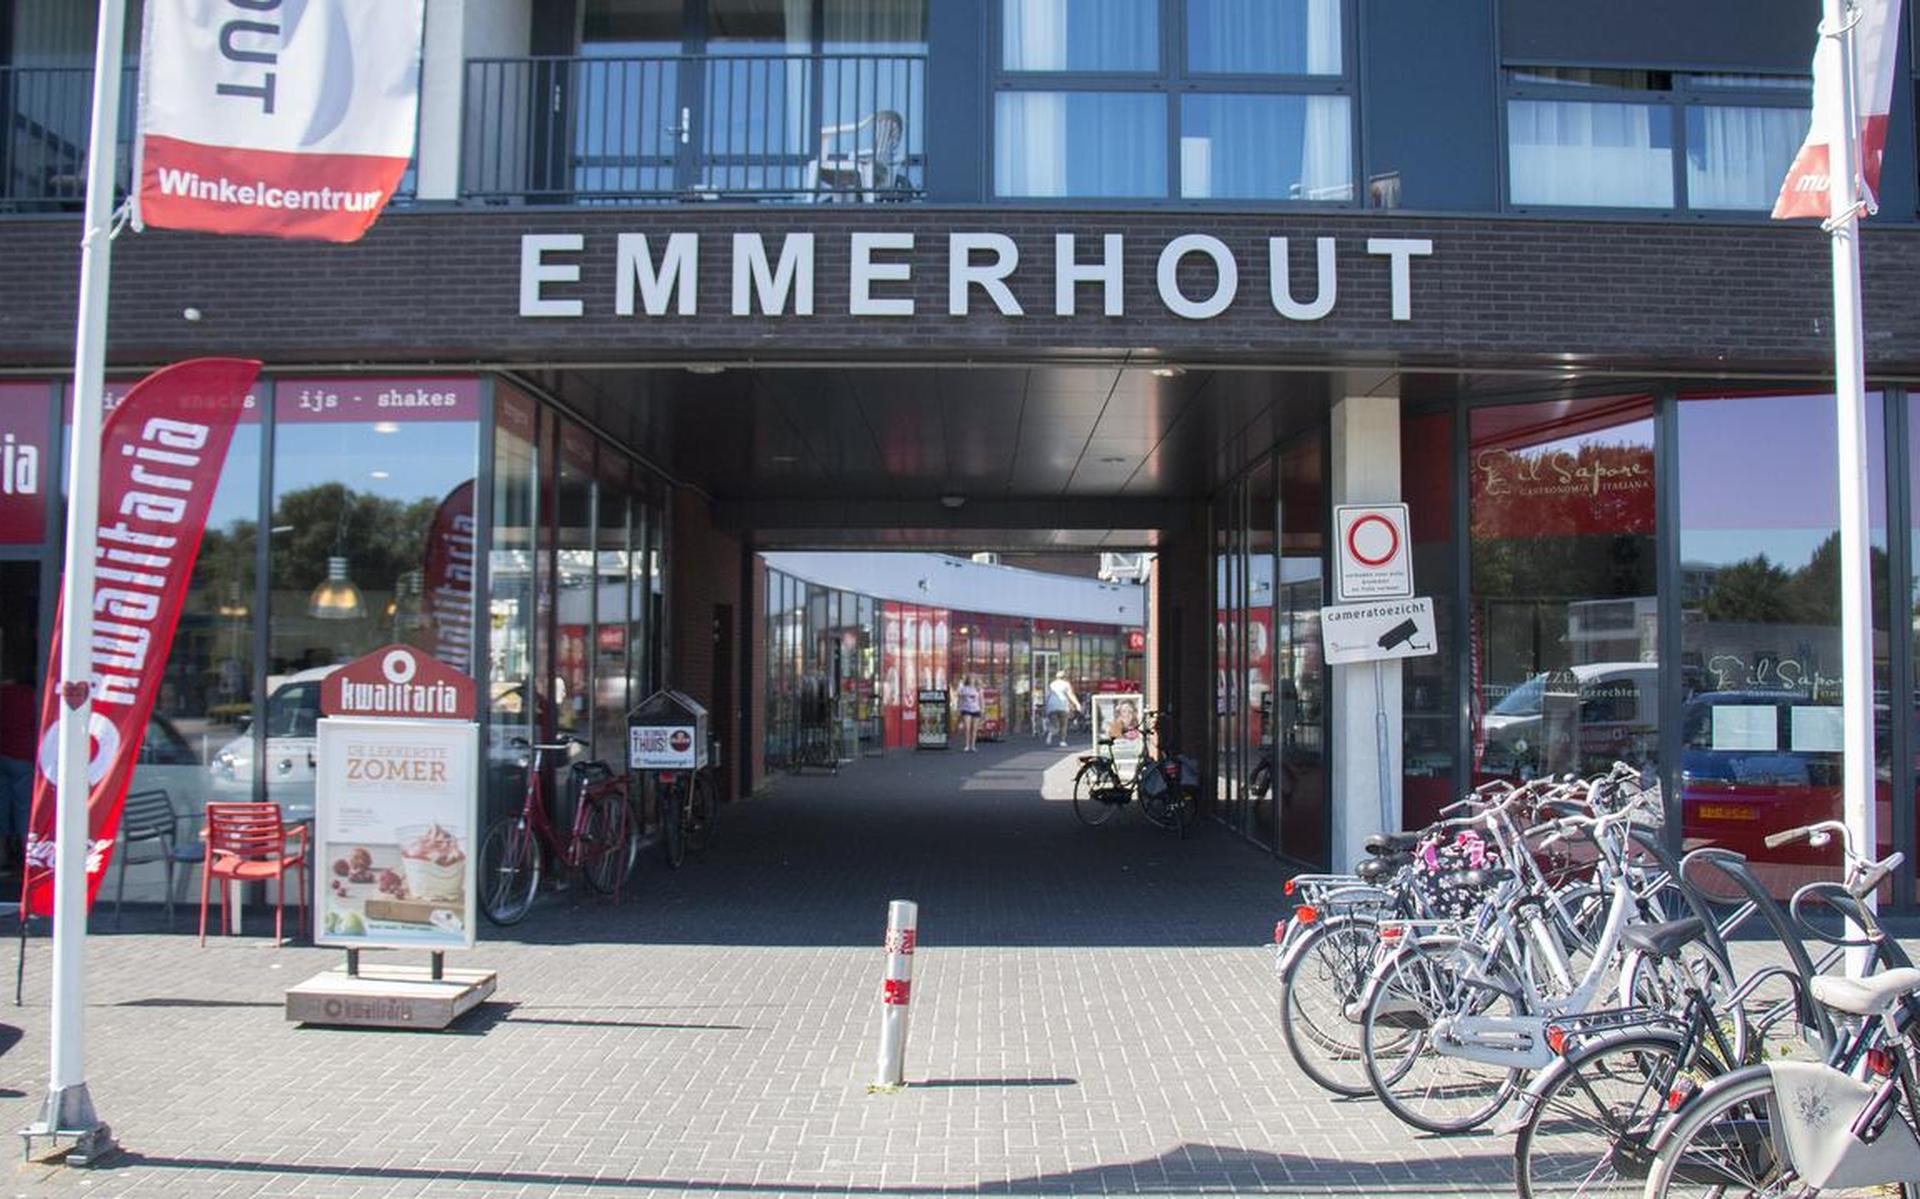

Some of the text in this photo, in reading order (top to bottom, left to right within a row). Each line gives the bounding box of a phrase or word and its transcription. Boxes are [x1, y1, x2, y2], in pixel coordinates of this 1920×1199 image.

[217, 0, 282, 114] UT
[519, 232, 1433, 320] EMMERHOUT
[300, 391, 338, 412] ijs
[378, 389, 457, 407] shakes
[1518, 452, 1648, 496] il Sapore
[1602, 480, 1649, 491] ITALIANA
[55, 417, 210, 706] kwalitaria
[1328, 603, 1426, 621] cameratoezicht
[1746, 658, 1770, 686] il
[341, 677, 457, 713] kwalitaria
[347, 759, 447, 782] ZOMER
